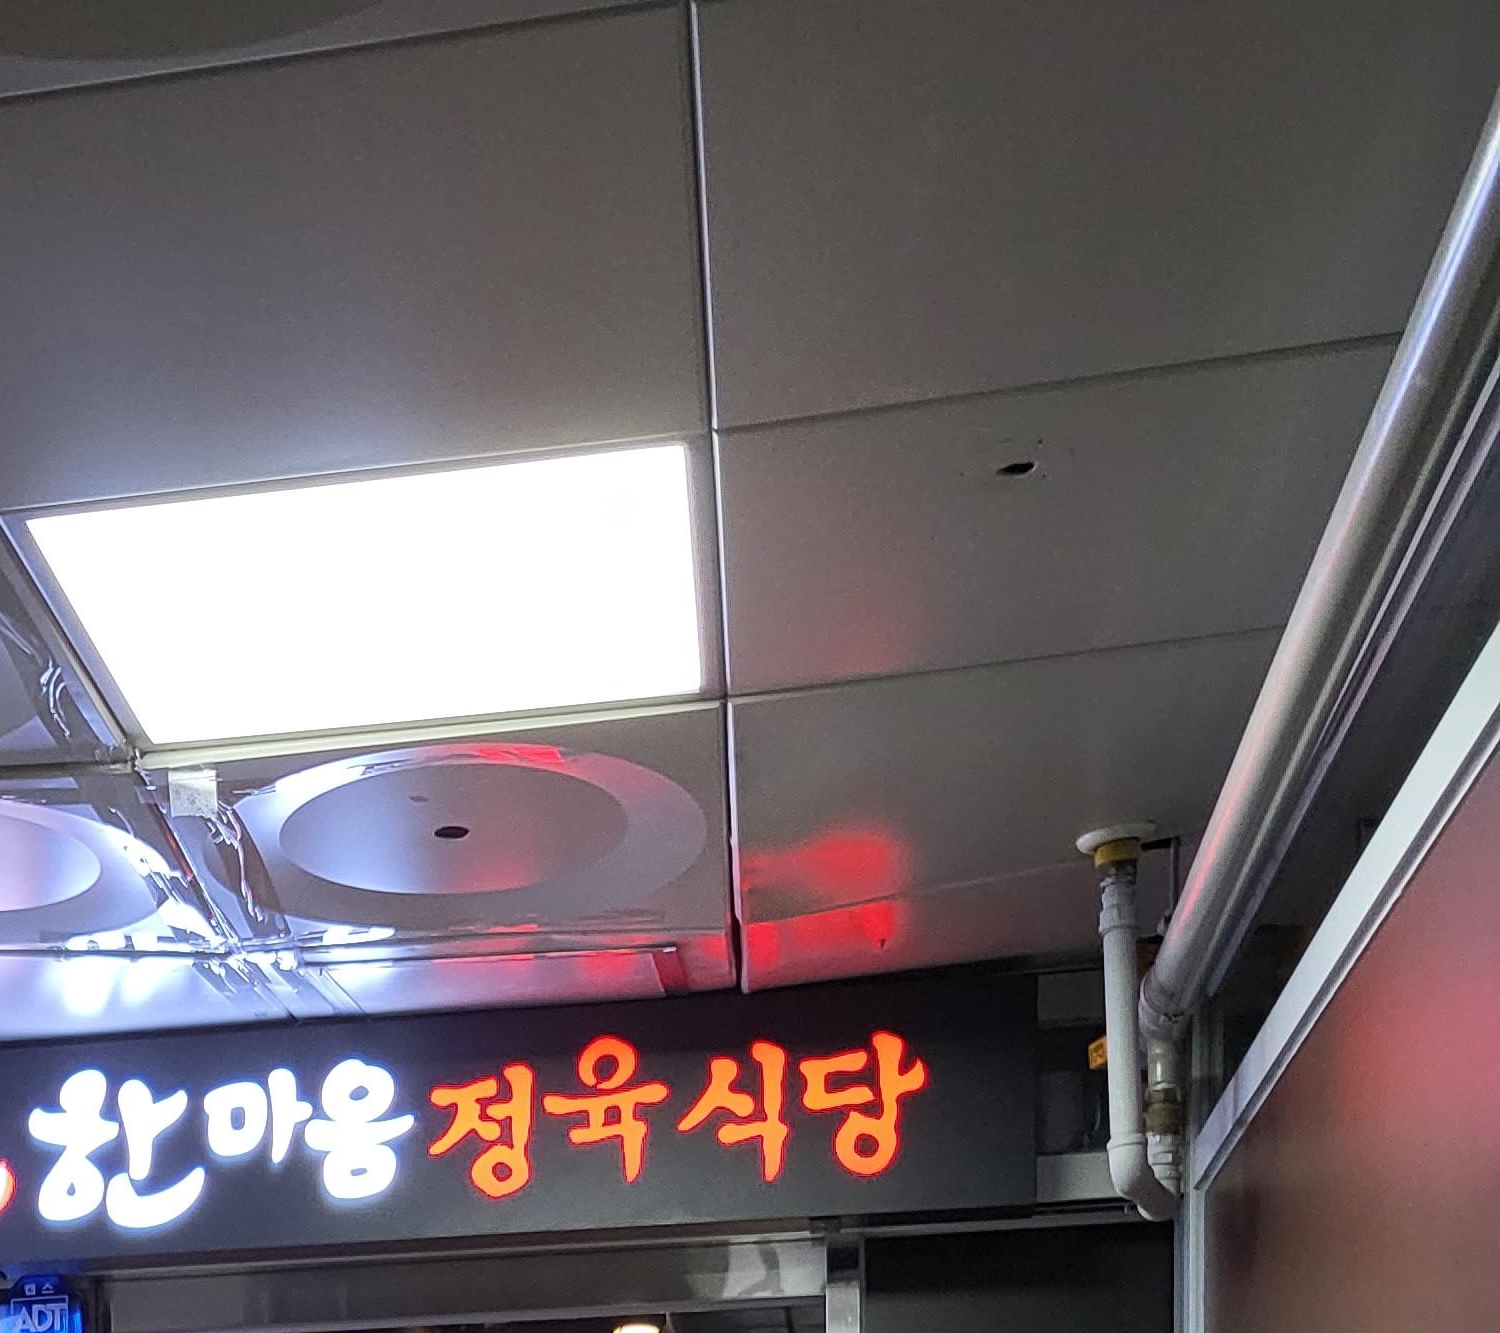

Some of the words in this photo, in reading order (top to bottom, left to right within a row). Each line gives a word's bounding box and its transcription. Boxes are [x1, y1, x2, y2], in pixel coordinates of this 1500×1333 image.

[28, 1057, 414, 1229] 한마음
[427, 1030, 927, 1200] 정육식당
[17, 1303, 67, 1333] ADT
